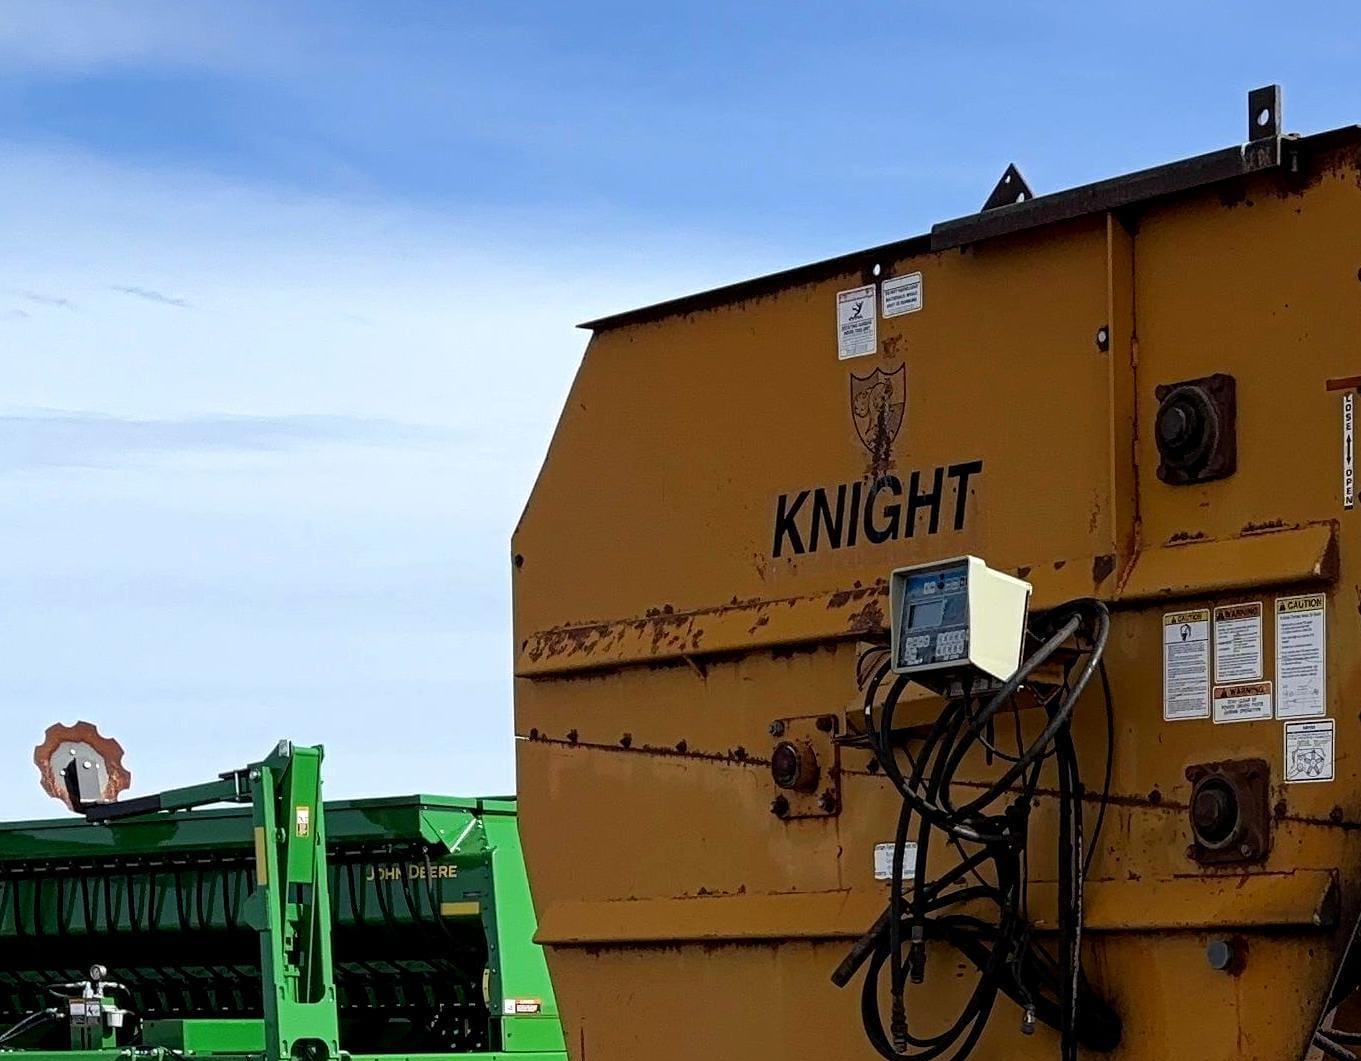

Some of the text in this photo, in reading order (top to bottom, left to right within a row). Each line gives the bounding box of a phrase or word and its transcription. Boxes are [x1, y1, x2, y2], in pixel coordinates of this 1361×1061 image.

[1345, 469, 1353, 504] OPEN
[772, 460, 983, 558] KNIGHT
[1287, 598, 1322, 610] CAUTION
[408, 864, 458, 879] DEERE
